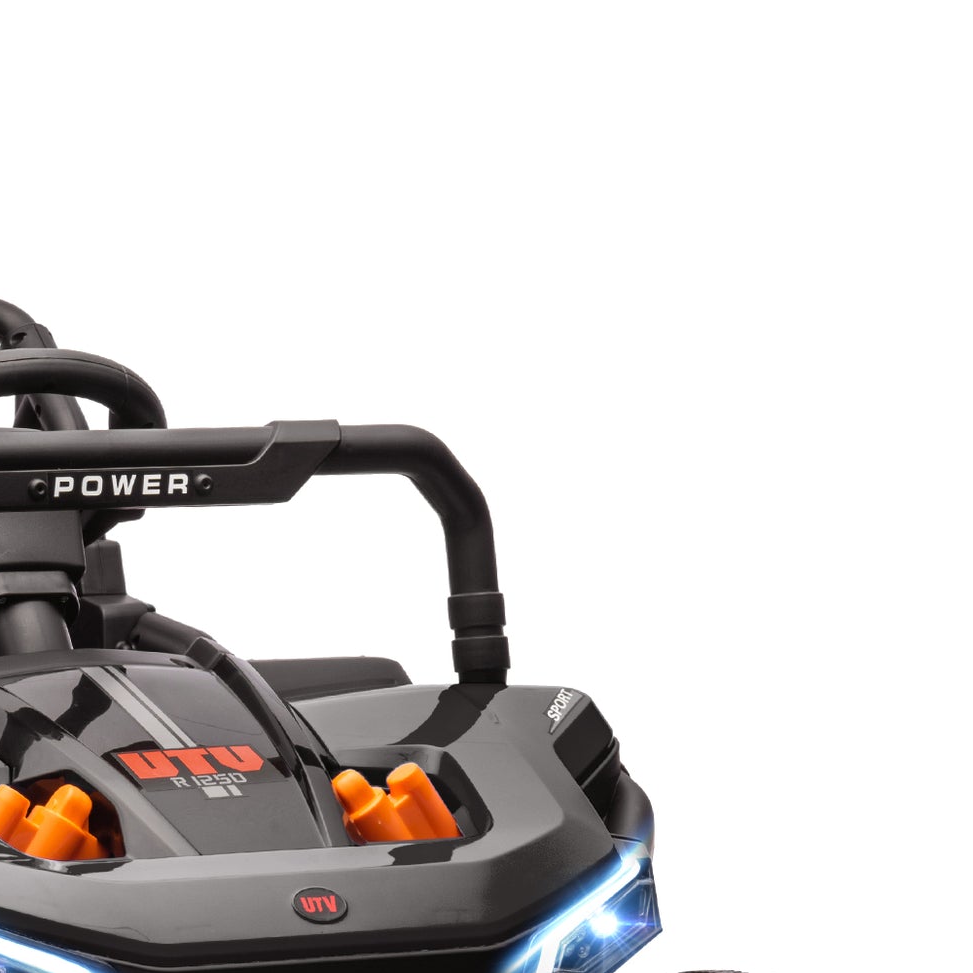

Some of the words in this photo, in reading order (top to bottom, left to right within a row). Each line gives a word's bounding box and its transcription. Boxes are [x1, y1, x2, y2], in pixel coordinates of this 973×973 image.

[53, 473, 189, 498] POWER
[547, 688, 573, 722] SPORT
[117, 745, 265, 780] UTV
[170, 776, 191, 788] R
[192, 772, 248, 787] 1250
[300, 894, 338, 913] UTV
